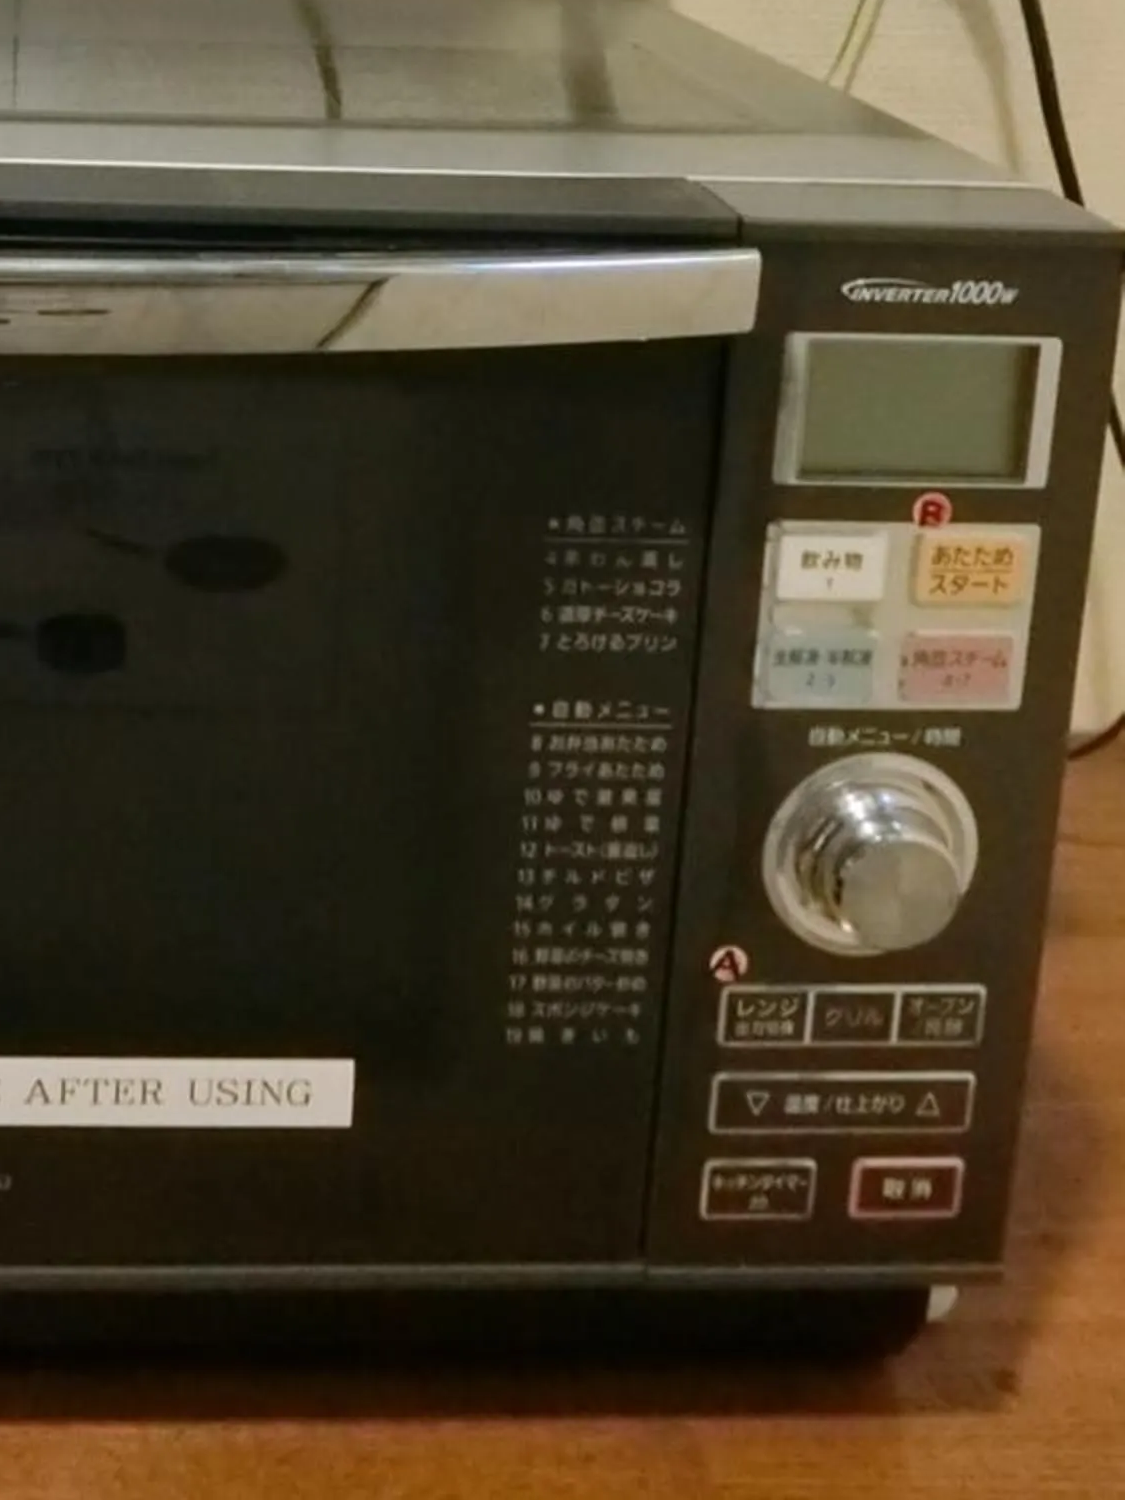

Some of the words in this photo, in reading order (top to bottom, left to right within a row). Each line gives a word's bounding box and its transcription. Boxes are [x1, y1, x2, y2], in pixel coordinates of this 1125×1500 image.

[801, 548, 864, 571] 飲み物
[930, 545, 1014, 567] あたため
[929, 574, 1008, 595] スタート
[713, 950, 740, 982] A
[735, 998, 800, 1018] レンジ
[825, 1008, 883, 1027] グリル
[23, 1076, 164, 1106] AFTER
[187, 1077, 313, 1108] USING
